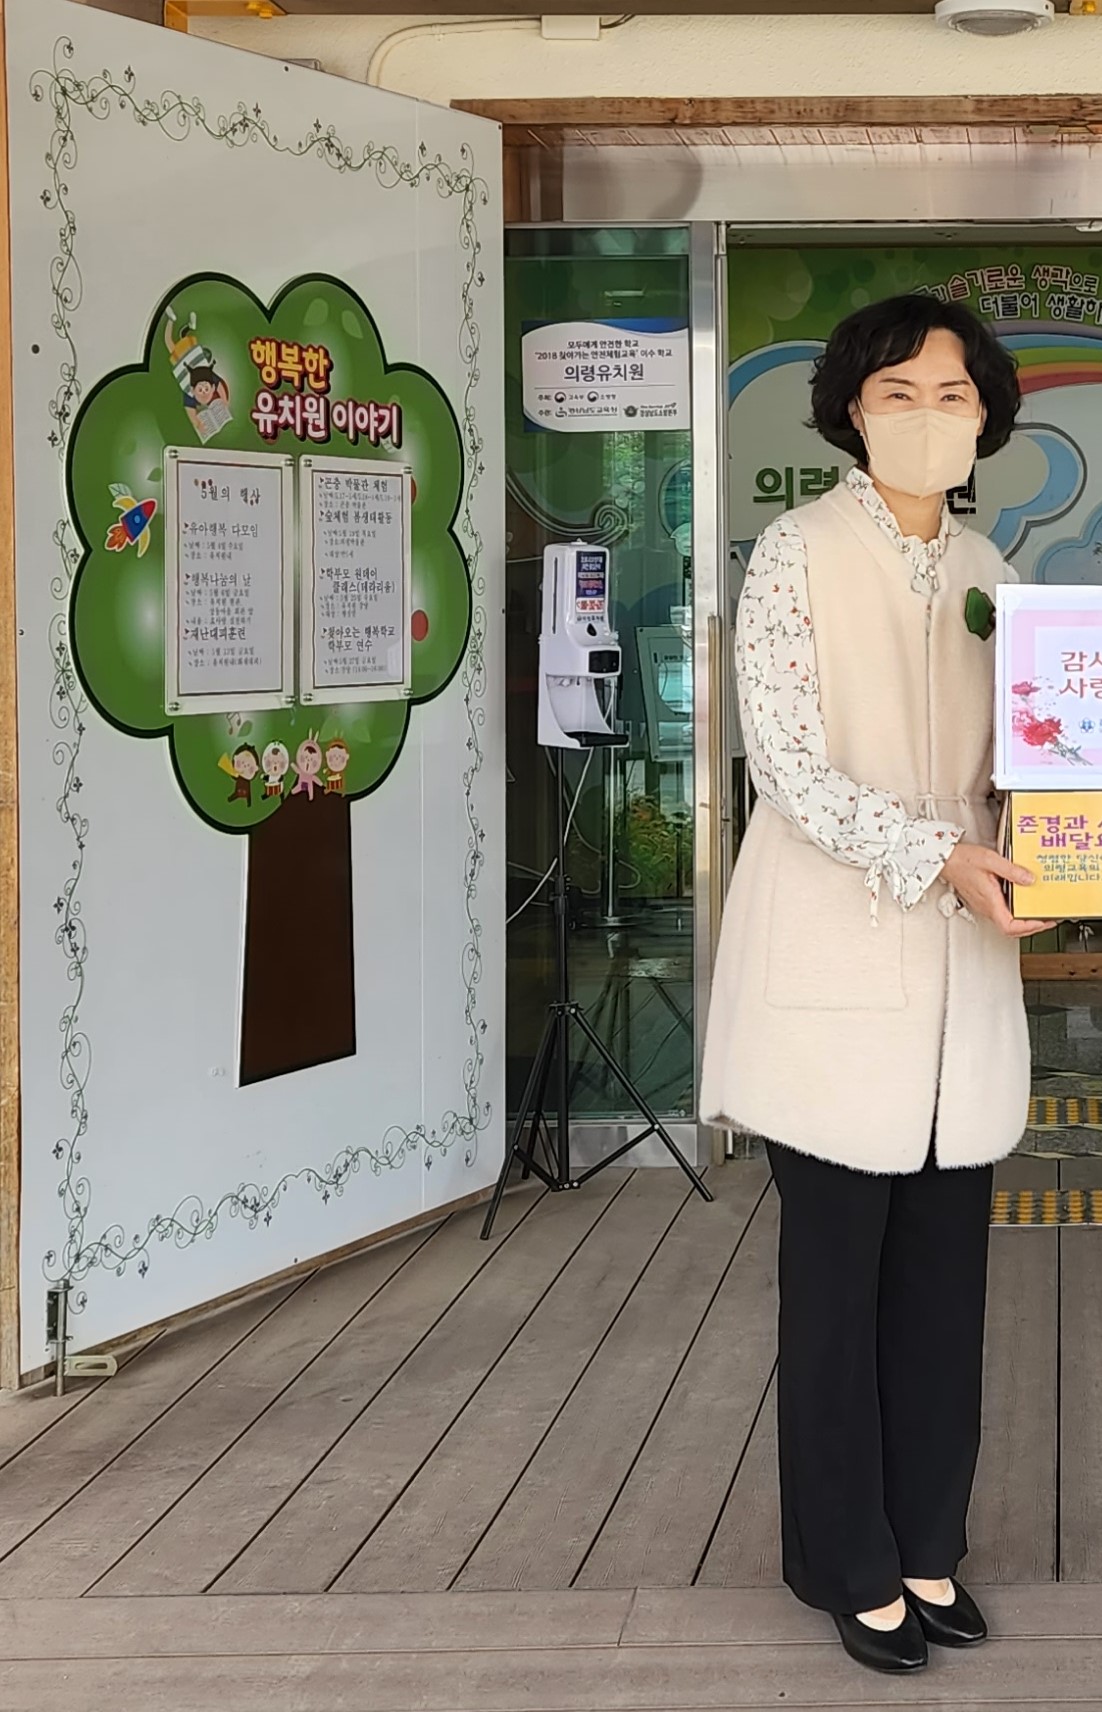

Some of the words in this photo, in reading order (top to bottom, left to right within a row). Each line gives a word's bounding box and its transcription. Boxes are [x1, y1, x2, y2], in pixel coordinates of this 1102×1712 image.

[949, 264, 1026, 300] 슬기로운
[1032, 265, 1099, 295] 생각으로
[979, 293, 1039, 319] 더불어
[568, 340, 598, 349] 모두에게
[624, 340, 639, 348] 학교
[657, 349, 673, 357] 학교
[250, 339, 330, 391] 행복한
[564, 363, 644, 382] 의령유치원
[251, 392, 326, 439] 유치원
[331, 400, 399, 445] 이야기
[1016, 814, 1088, 834] 존경과
